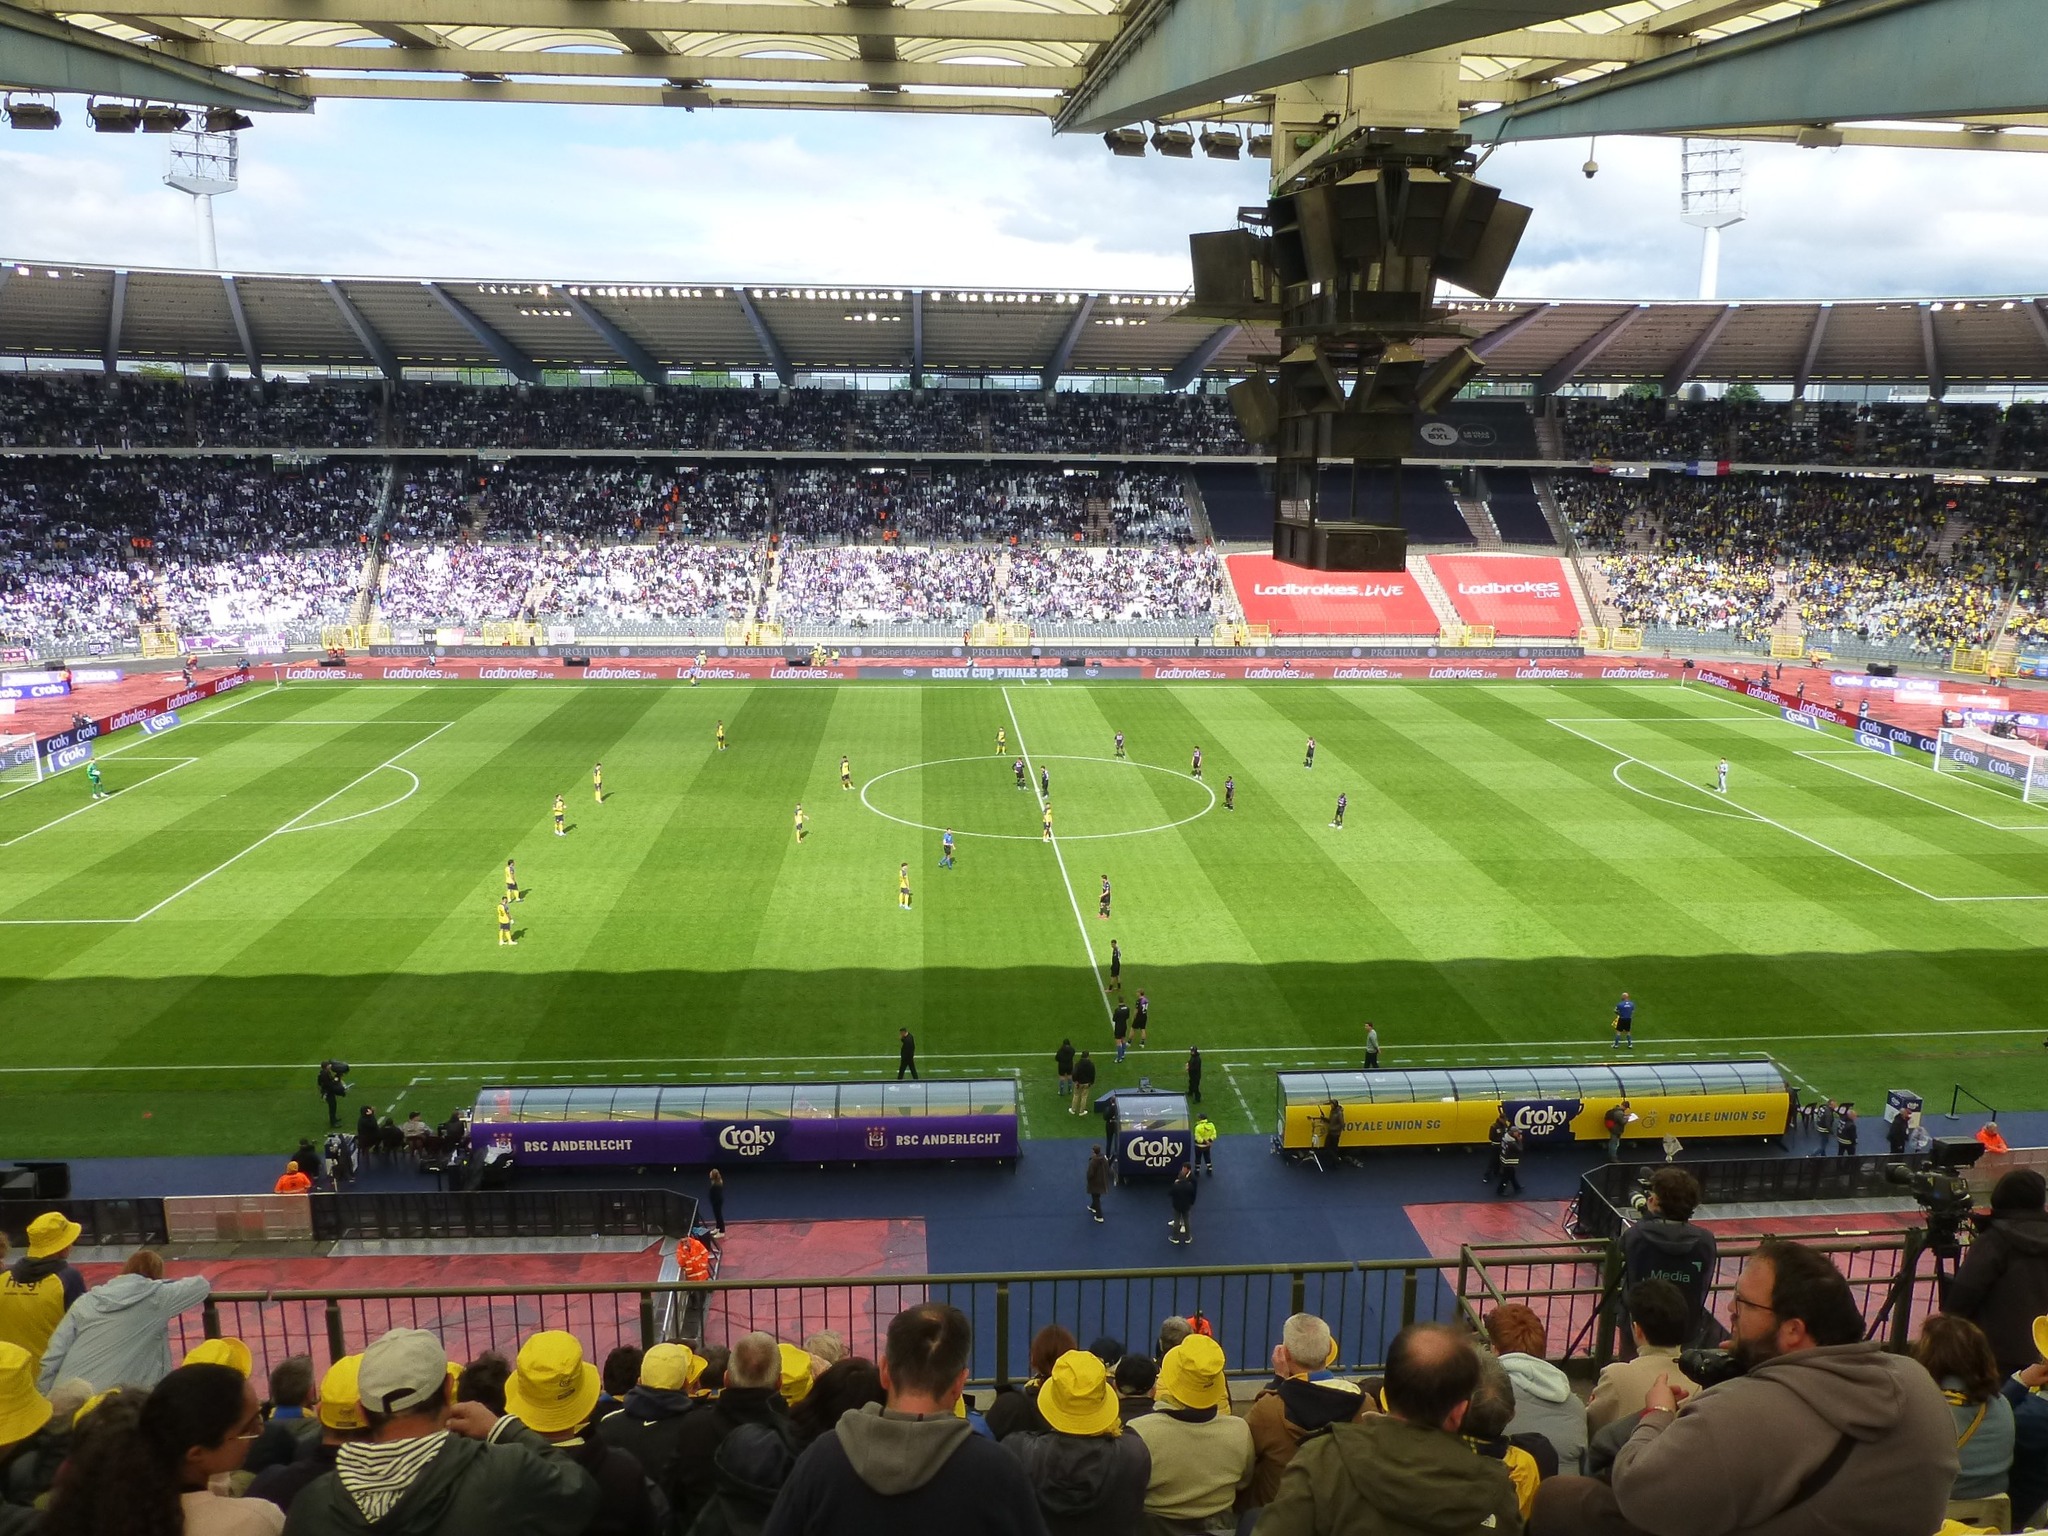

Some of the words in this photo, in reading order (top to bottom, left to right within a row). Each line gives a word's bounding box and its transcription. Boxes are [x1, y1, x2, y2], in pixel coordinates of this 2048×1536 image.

[1458, 581, 1559, 595] Ladbrokes
[932, 668, 969, 678] CROKY
[971, 668, 994, 678] CUP
[997, 668, 1038, 678] FINALE
[1039, 668, 1069, 678] 2026
[151, 713, 173, 731] Croky
[1785, 710, 1809, 725] Croky
[77, 724, 97, 742] Croky
[1859, 719, 1882, 736] Croky
[47, 734, 69, 753] Croky
[1859, 734, 1885, 750] Croky
[1889, 728, 1912, 745] Croky
[15, 745, 35, 764] Crok
[58, 746, 86, 768] Croky
[1953, 748, 1979, 765] Croky
[1988, 759, 2016, 777] Croky
[1387, 1119, 1424, 1131] UNION
[1426, 1119, 1441, 1130] SG
[1514, 1105, 1567, 1131] Croky
[1669, 1112, 1711, 1124] ROYALE
[1714, 1111, 1748, 1122] UNION
[1751, 1110, 1767, 1121] SG
[719, 1124, 776, 1150] Croky
[1530, 1125, 1555, 1136] CUP
[524, 1140, 549, 1152] RSC
[552, 1139, 633, 1152] ANDERLECHT
[895, 1134, 920, 1146] RSC
[922, 1132, 1002, 1146] ANDERLECHT
[739, 1145, 765, 1156] CUP
[1127, 1136, 1183, 1162] Croky
[1145, 1156, 1172, 1168] CUP
[1650, 1269, 1691, 1283] Media
